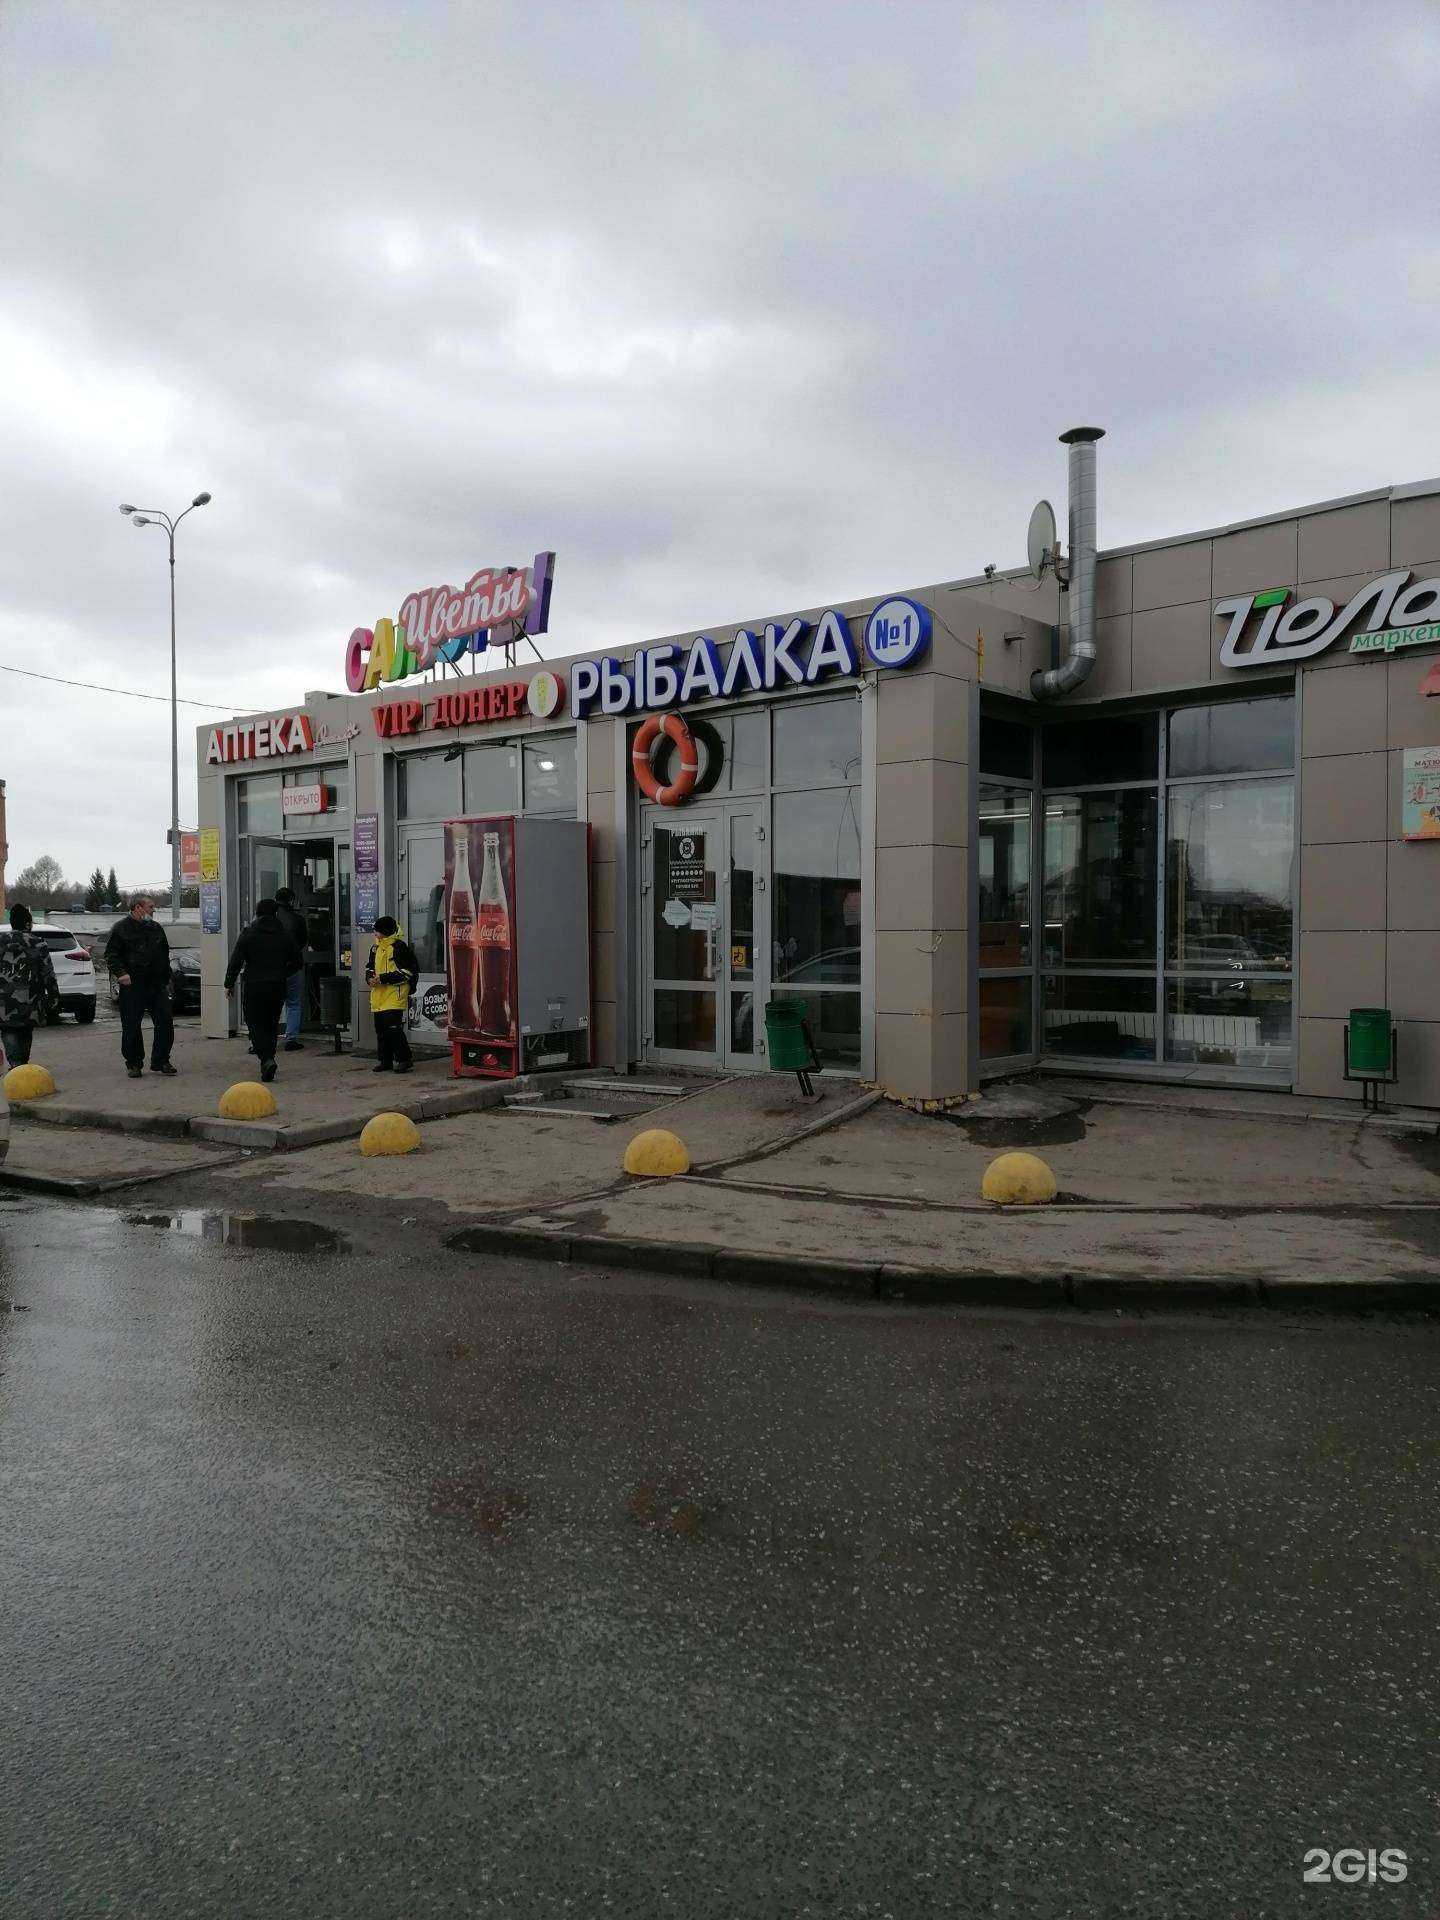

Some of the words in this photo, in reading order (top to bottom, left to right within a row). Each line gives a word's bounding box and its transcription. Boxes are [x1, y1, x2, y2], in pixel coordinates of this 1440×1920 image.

[400, 571, 529, 664] Цветы
[875, 614, 912, 650] №1
[571, 610, 858, 719] РЫБАЛКА
[371, 700, 423, 737] VIP
[431, 681, 528, 729] ДОНЕР
[206, 714, 314, 764] АПТЕКА
[284, 792, 320, 807] ОТКРЫТО
[424, 993, 448, 1005] ВОЗЬМ
[430, 1004, 448, 1014] СОБО
